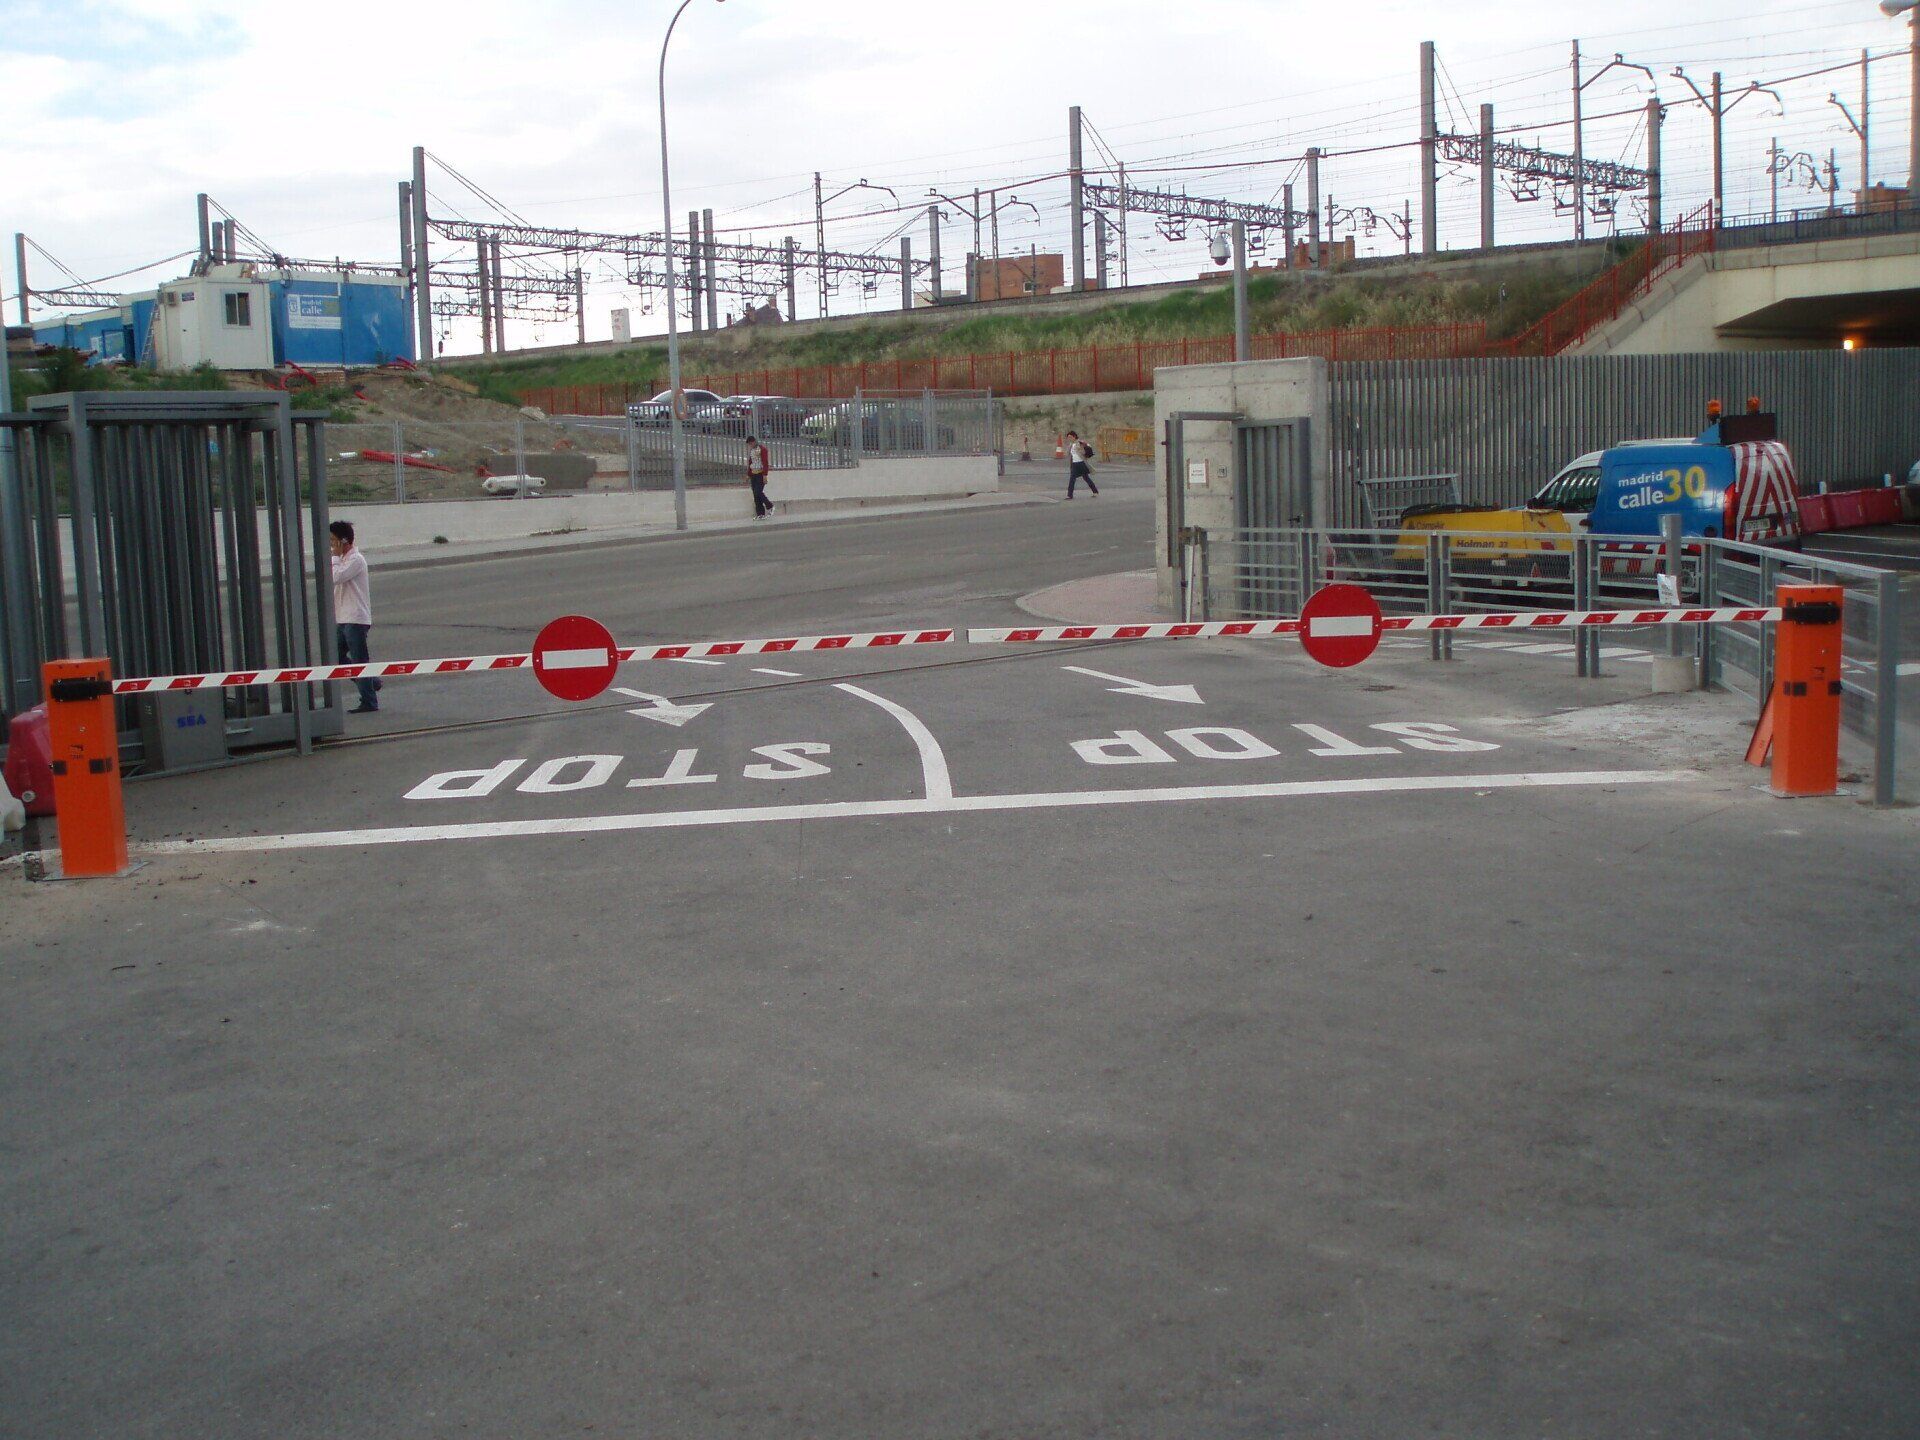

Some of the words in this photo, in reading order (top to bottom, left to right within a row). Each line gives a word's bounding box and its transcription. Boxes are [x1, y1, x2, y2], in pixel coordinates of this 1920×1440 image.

[301, 305, 322, 314] calle
[1618, 471, 1664, 487] madrid
[1618, 486, 1664, 509] calle
[1664, 465, 1706, 502] 30
[1069, 721, 1502, 765] STOP
[403, 742, 831, 799] STOP
